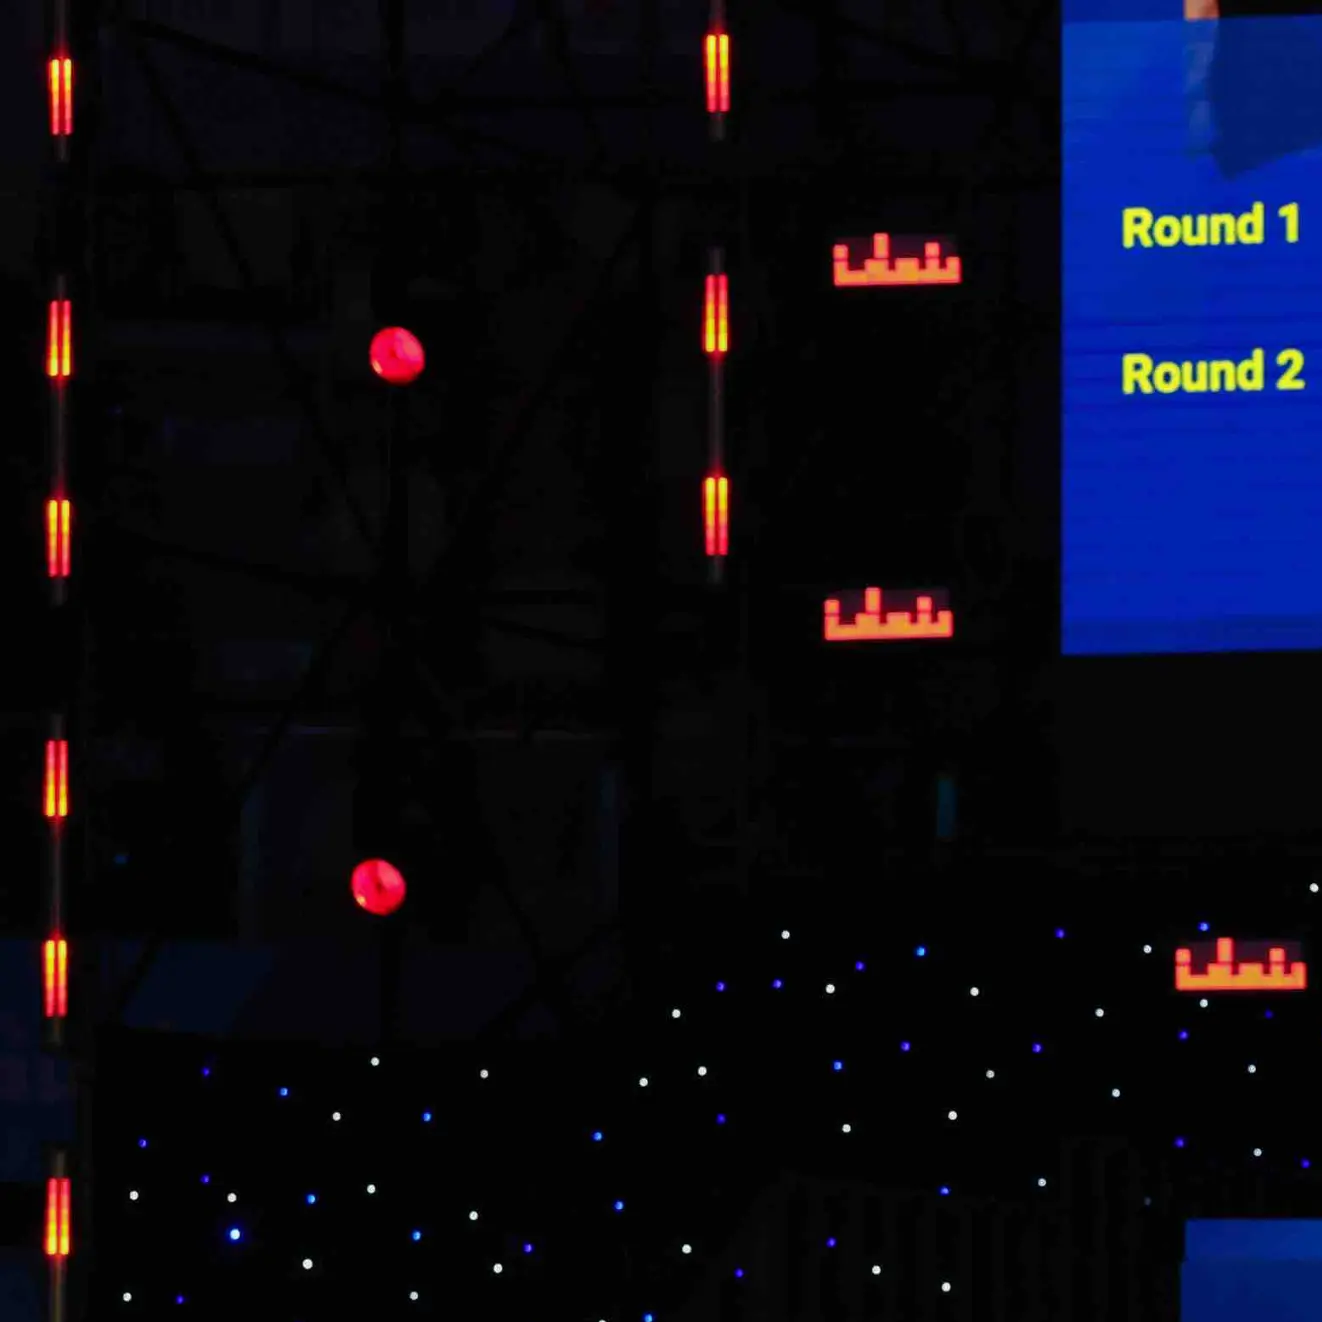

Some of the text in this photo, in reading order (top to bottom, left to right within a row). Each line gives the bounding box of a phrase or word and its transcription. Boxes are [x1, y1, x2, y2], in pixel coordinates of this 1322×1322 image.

[1124, 203, 1297, 247] Round 1
[1124, 349, 1304, 394] Round 2
